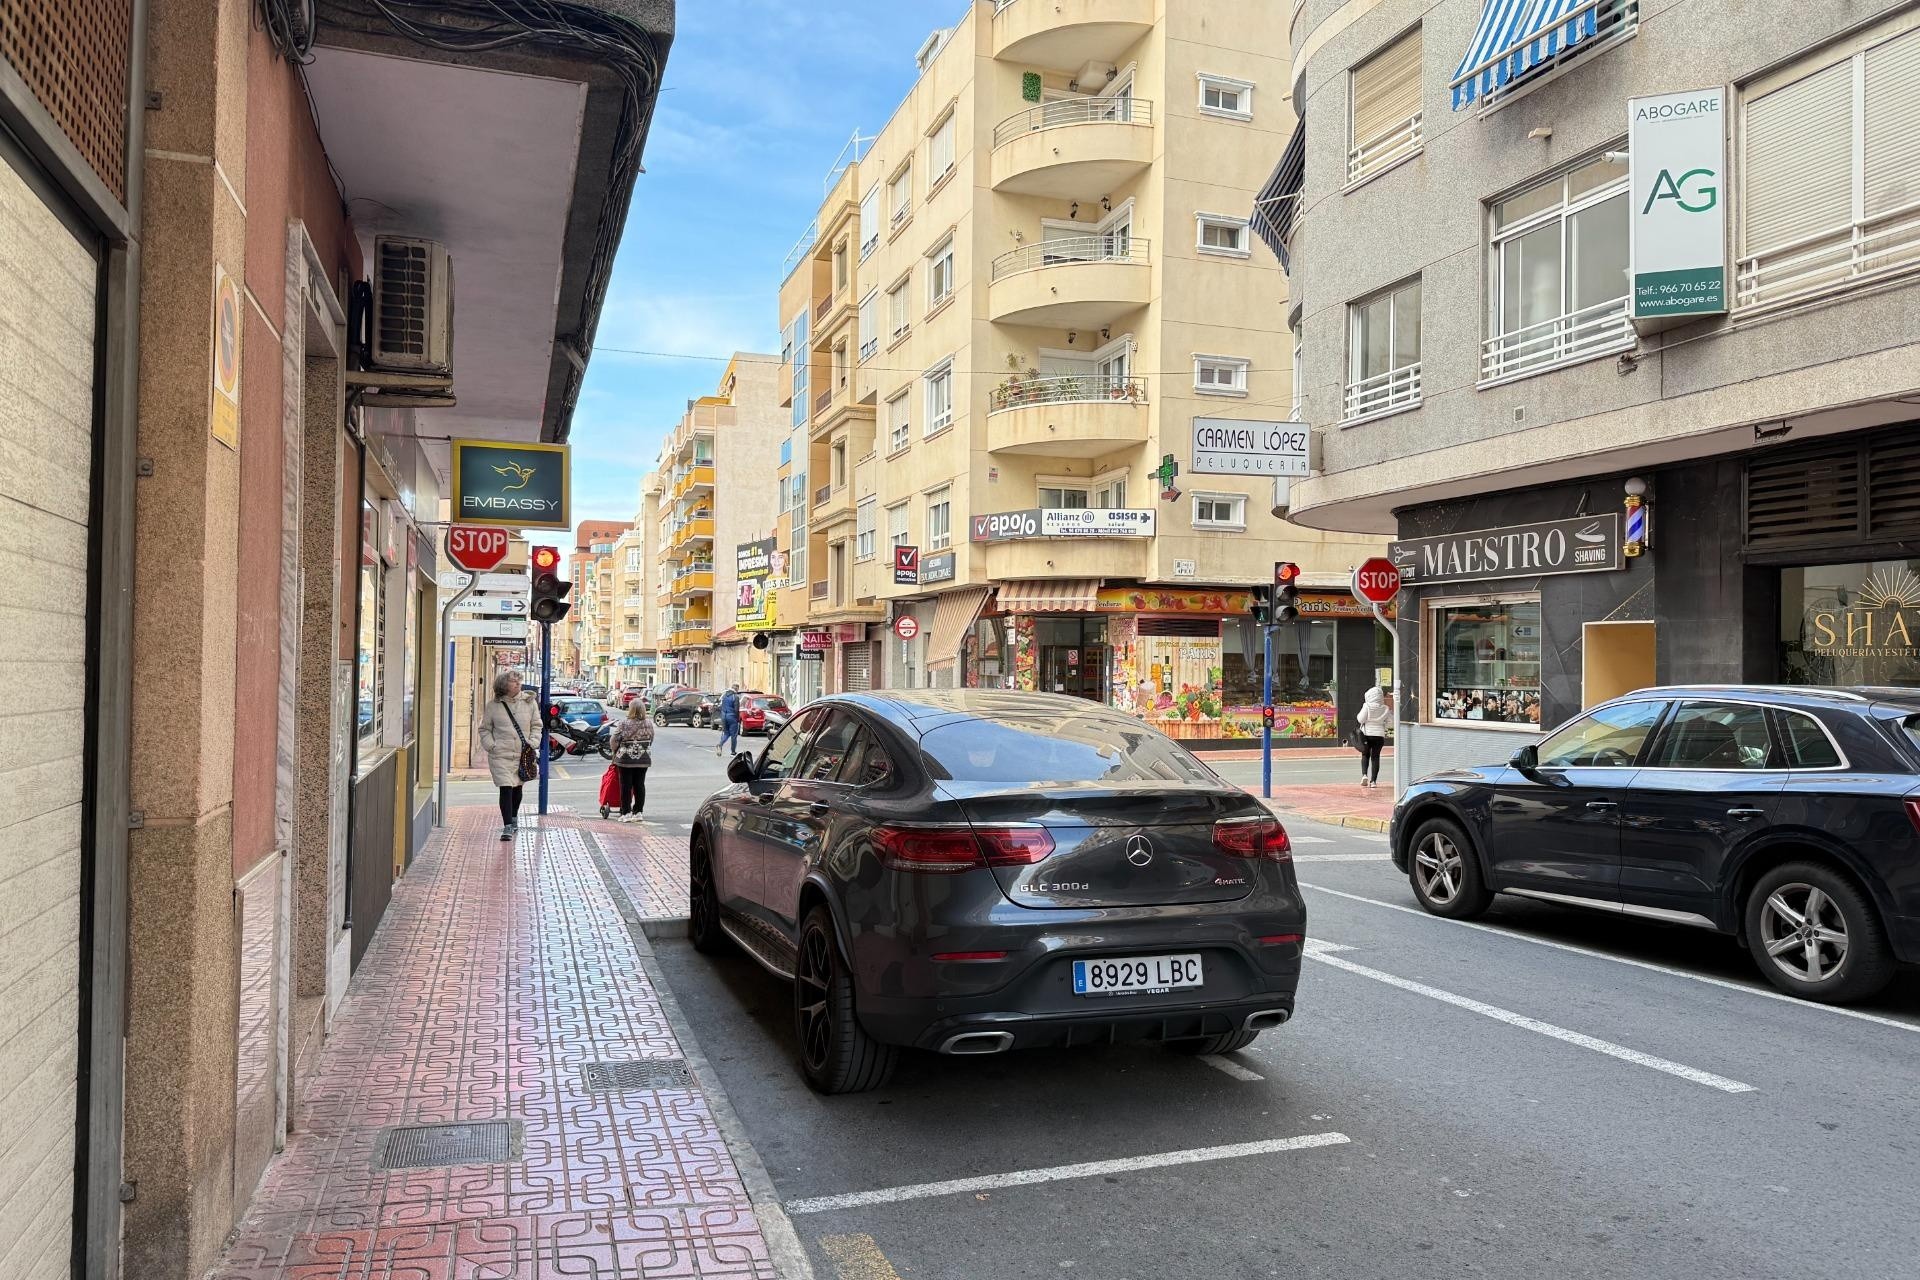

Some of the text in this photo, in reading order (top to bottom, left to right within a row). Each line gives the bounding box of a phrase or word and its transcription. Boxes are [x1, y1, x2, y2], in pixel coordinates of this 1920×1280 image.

[1637, 98, 1719, 120] ABOGARE
[1642, 169, 1717, 214] AG
[1636, 281, 1720, 295] Telf.: 966 70 65 22
[1640, 295, 1718, 307] www.abogare.es
[1196, 426, 1306, 451] CARMEN LÓPEZ
[1196, 457, 1306, 471] PELUQUERÍA
[463, 496, 558, 510] EMBASSY
[1046, 512, 1080, 522] Allianz
[1108, 512, 1138, 521] asisa
[990, 513, 1036, 536] apolo
[452, 529, 505, 553] STOP
[1422, 528, 1566, 577] MAESTRO
[1574, 548, 1606, 563] SHAVING
[1360, 572, 1398, 589] STOP
[1294, 597, 1331, 612] Paris
[1814, 611, 1920, 646] SHA
[803, 633, 832, 643] NAILS
[1179, 648, 1216, 660] PARIS
[1814, 647, 1875, 657] PELUQUERÍA
[1876, 648, 1883, 656] Y
[1020, 882, 1089, 892] GLC 300d
[1091, 959, 1198, 988] 8929 LBC
